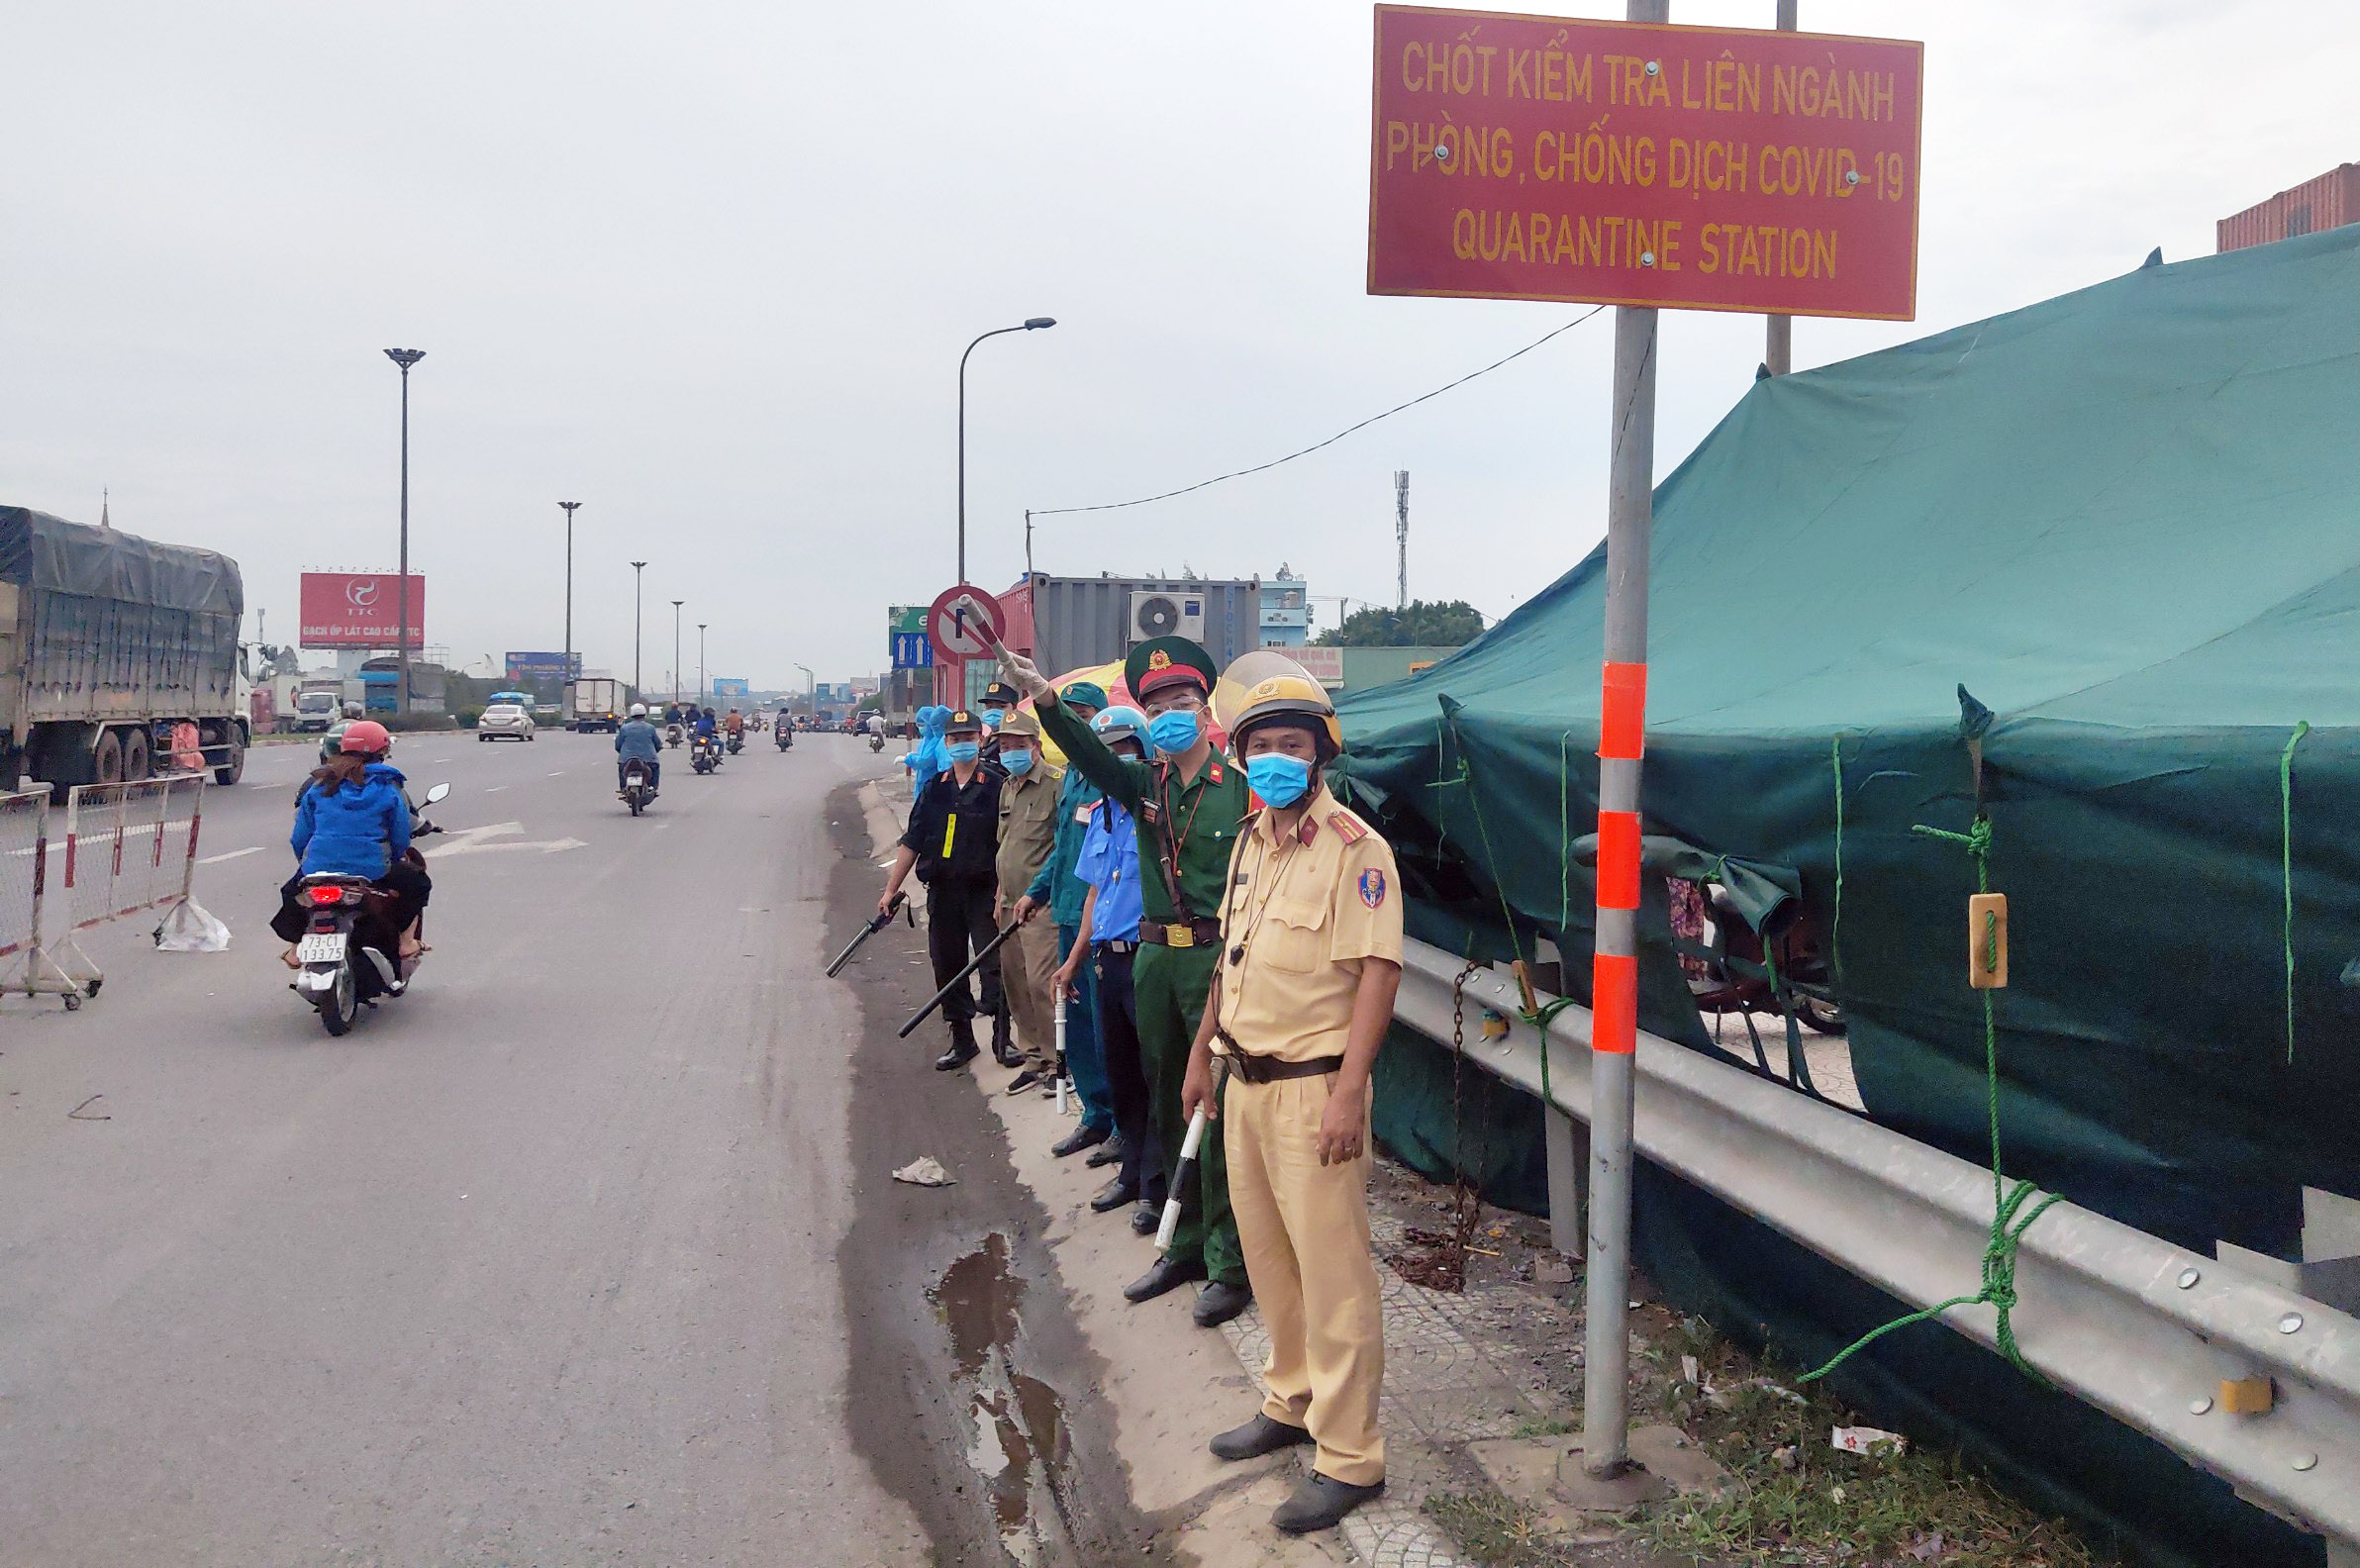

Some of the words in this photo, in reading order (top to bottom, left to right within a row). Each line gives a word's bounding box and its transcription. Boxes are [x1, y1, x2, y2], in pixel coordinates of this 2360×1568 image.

[1402, 25, 1498, 97] CHỐT
[1507, 28, 1593, 103] KIỂM
[1603, 53, 1672, 108] TRA
[1683, 49, 1761, 113] LIÊN
[1773, 51, 1896, 123] NGÀNH
[1533, 112, 1657, 187] CHỐNG
[1668, 138, 1749, 200] DỊCH
[1758, 144, 1905, 203] COVID-19
[1453, 208, 1683, 271] QUARANTINE
[1698, 223, 1838, 279] STATION
[346, 608, 381, 617] TTC
[309, 935, 338, 948] 73-C1
